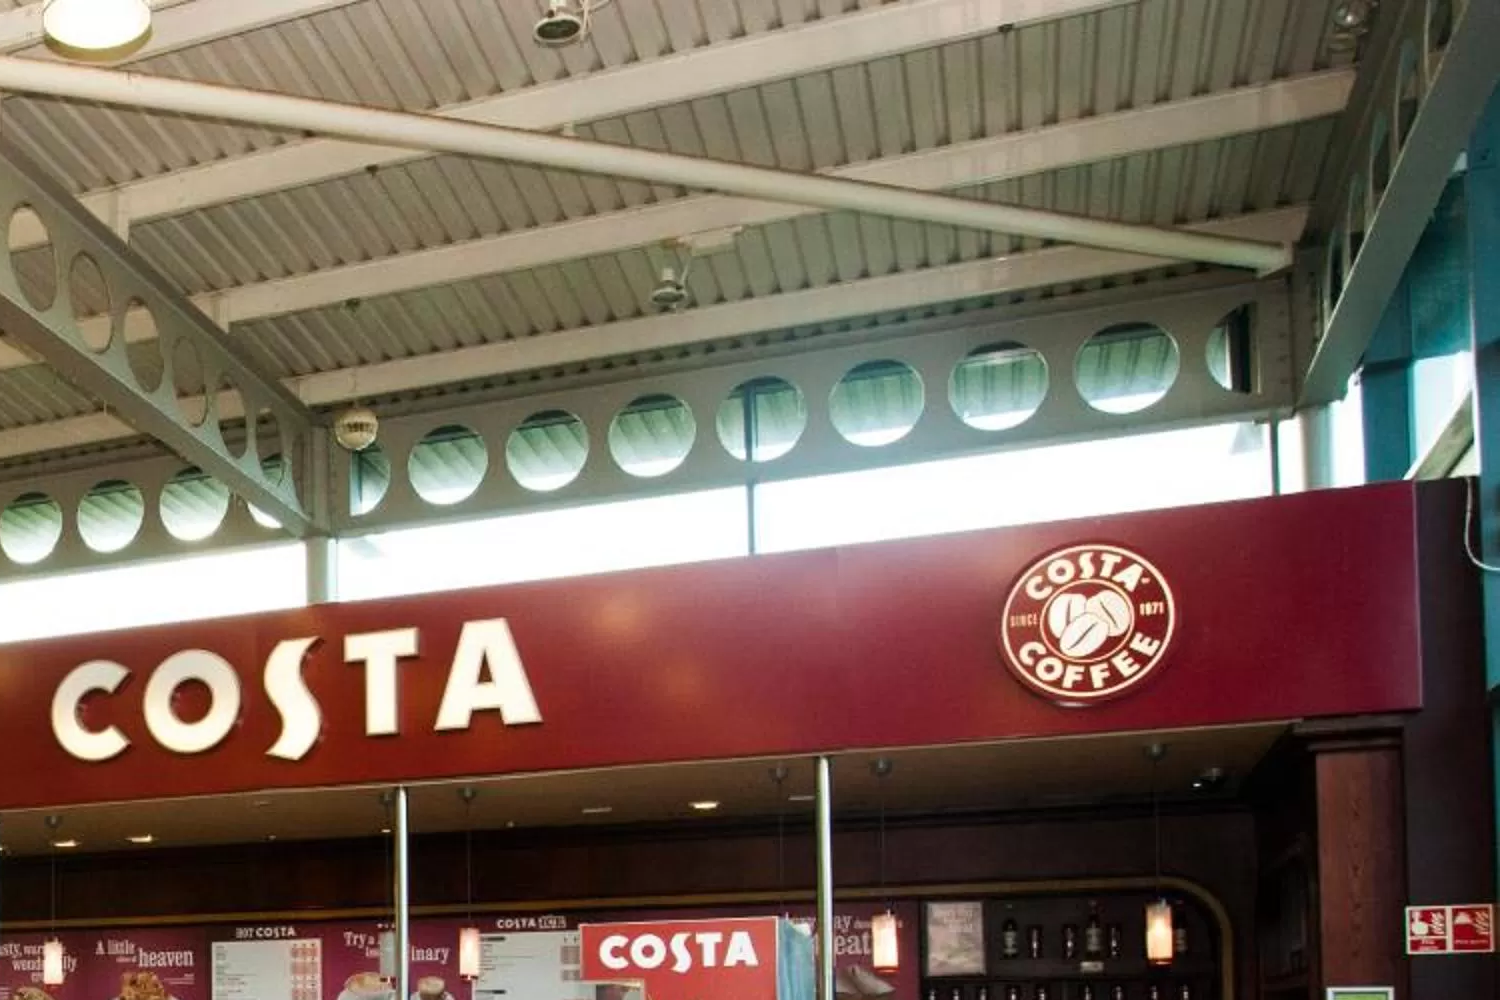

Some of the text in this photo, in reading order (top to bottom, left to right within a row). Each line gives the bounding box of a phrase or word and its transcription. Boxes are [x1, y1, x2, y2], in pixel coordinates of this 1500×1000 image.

[1025, 552, 1145, 600] COSTA
[1019, 632, 1160, 688] COFFEE
[51, 617, 543, 760] COSTA
[256, 926, 297, 938] COSTA
[600, 931, 758, 973] COSTA
[138, 948, 193, 968] heaven
